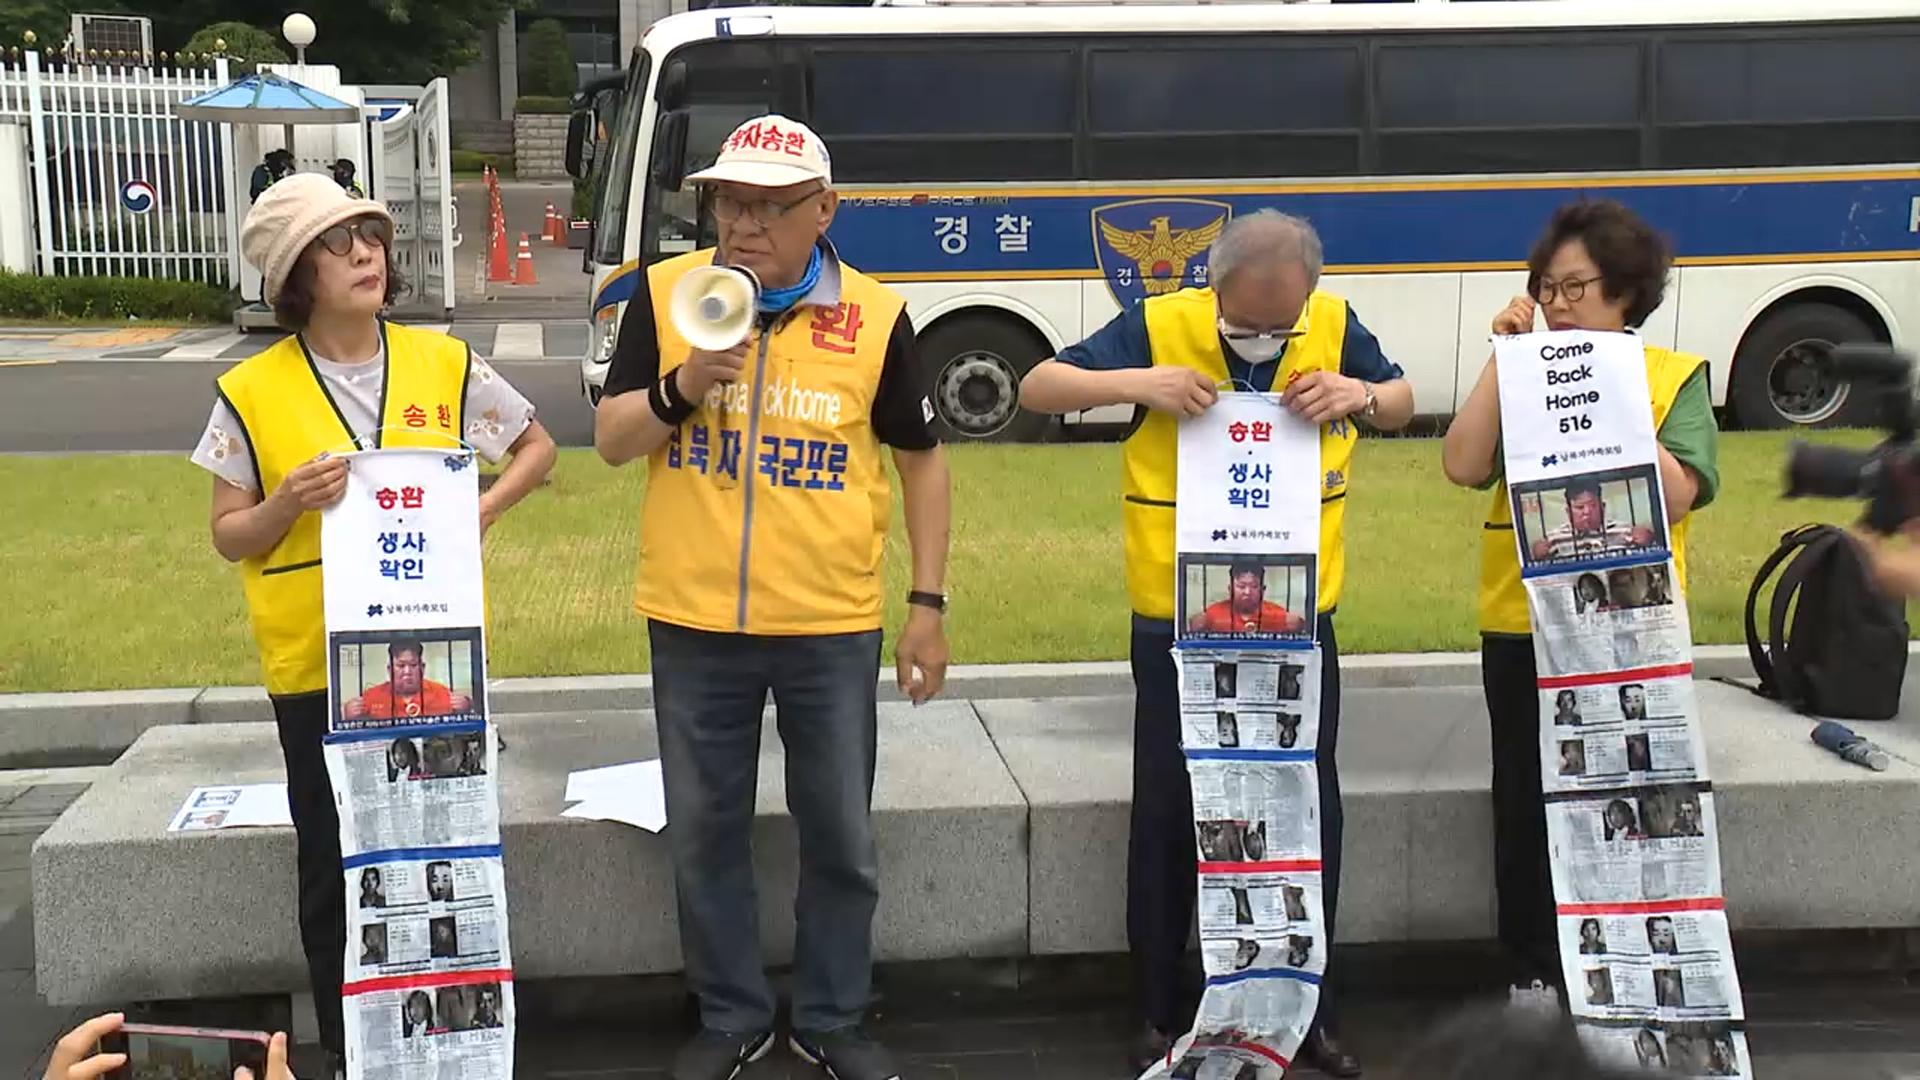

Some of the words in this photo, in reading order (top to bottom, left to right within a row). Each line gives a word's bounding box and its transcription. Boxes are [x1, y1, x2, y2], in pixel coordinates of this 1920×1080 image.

[1117, 268, 1132, 286] 경
[1540, 341, 1594, 361] Come
[1546, 364, 1593, 386] Back
[788, 377, 841, 425] home
[1546, 391, 1600, 411] Home
[1228, 421, 1272, 442] 송환
[1559, 414, 1593, 433] 516
[758, 435, 848, 489] 국군포로
[1228, 463, 1272, 483] 생사
[375, 486, 424, 510] 송환
[1228, 488, 1270, 508] 확인
[377, 532, 425, 553] 생사
[379, 558, 424, 580] 확인
